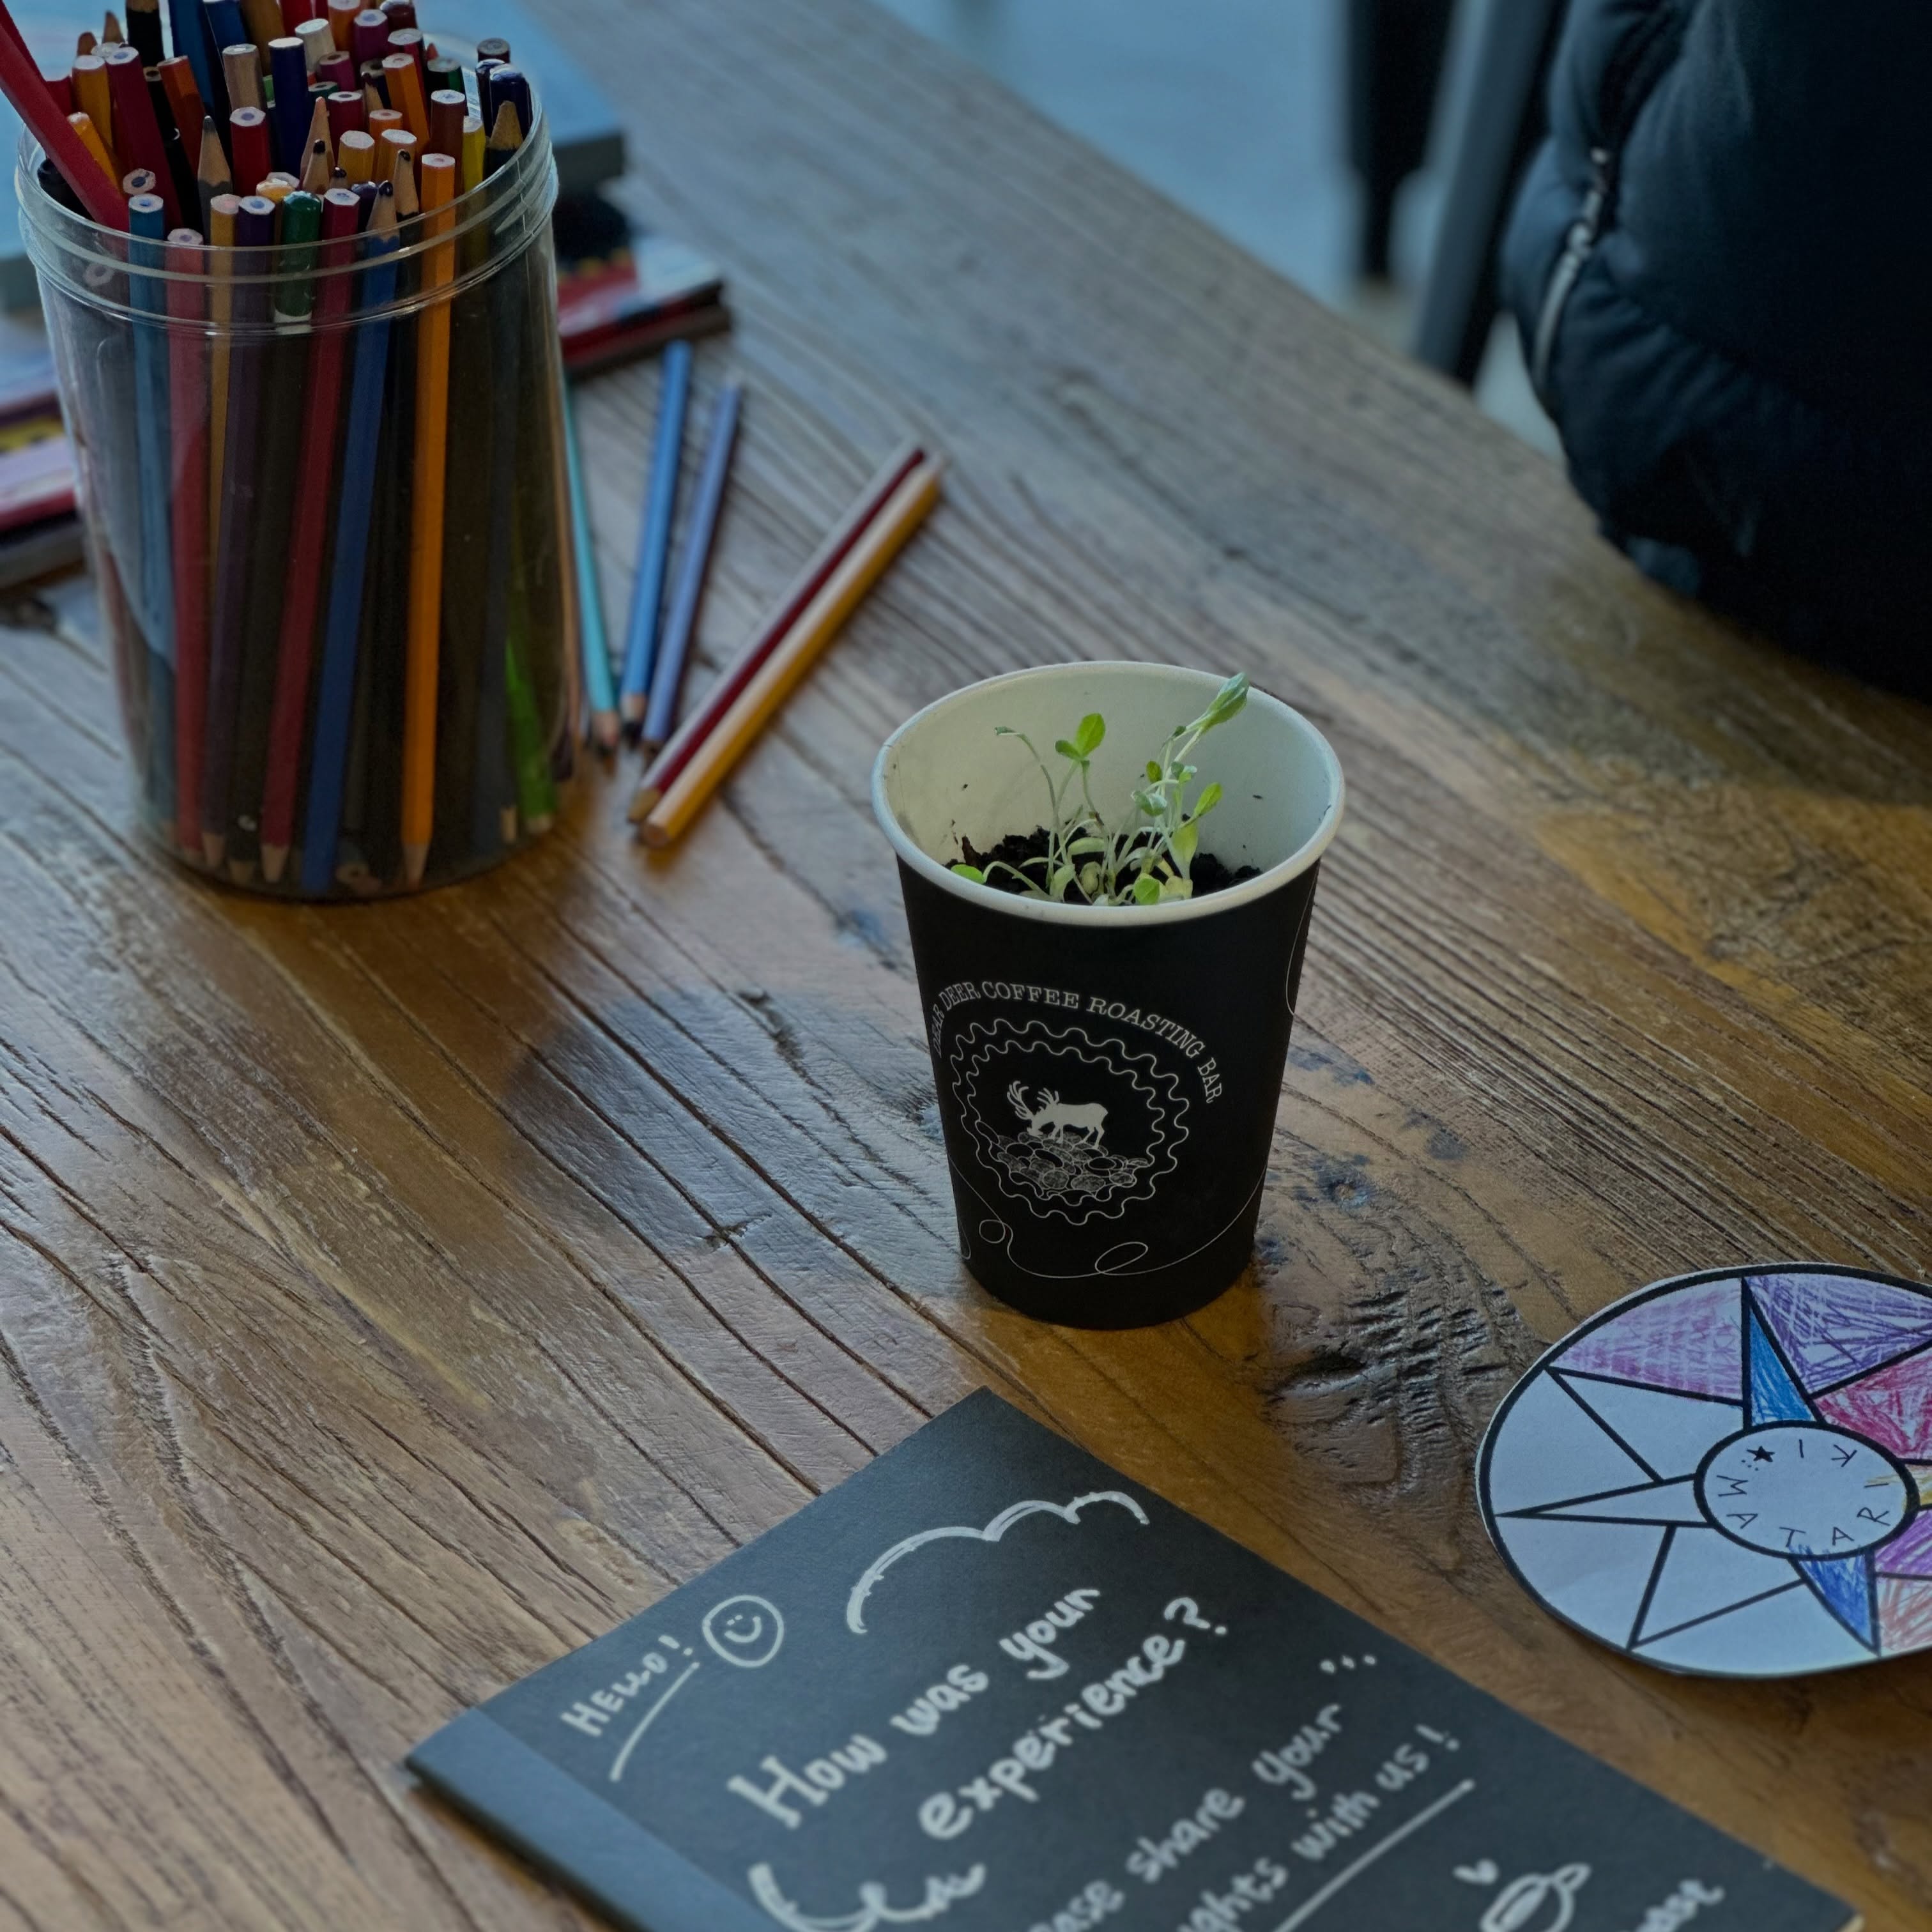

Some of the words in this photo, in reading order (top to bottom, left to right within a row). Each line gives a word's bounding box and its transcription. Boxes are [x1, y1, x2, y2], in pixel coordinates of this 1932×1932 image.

[939, 981, 981, 1011] DEER
[981, 981, 1080, 1009] COFFEE
[1086, 996, 1206, 1059] ROASTING
[1197, 1057, 1222, 1103] BAR
[727, 1735, 887, 1830] How
[891, 1665, 989, 1736] was
[999, 1589, 1101, 1680] your
[919, 1597, 1227, 1839] experience?
[1126, 1788, 1245, 1883] share
[1252, 1703, 1341, 1800] your
[1290, 1791, 1380, 1860] with
